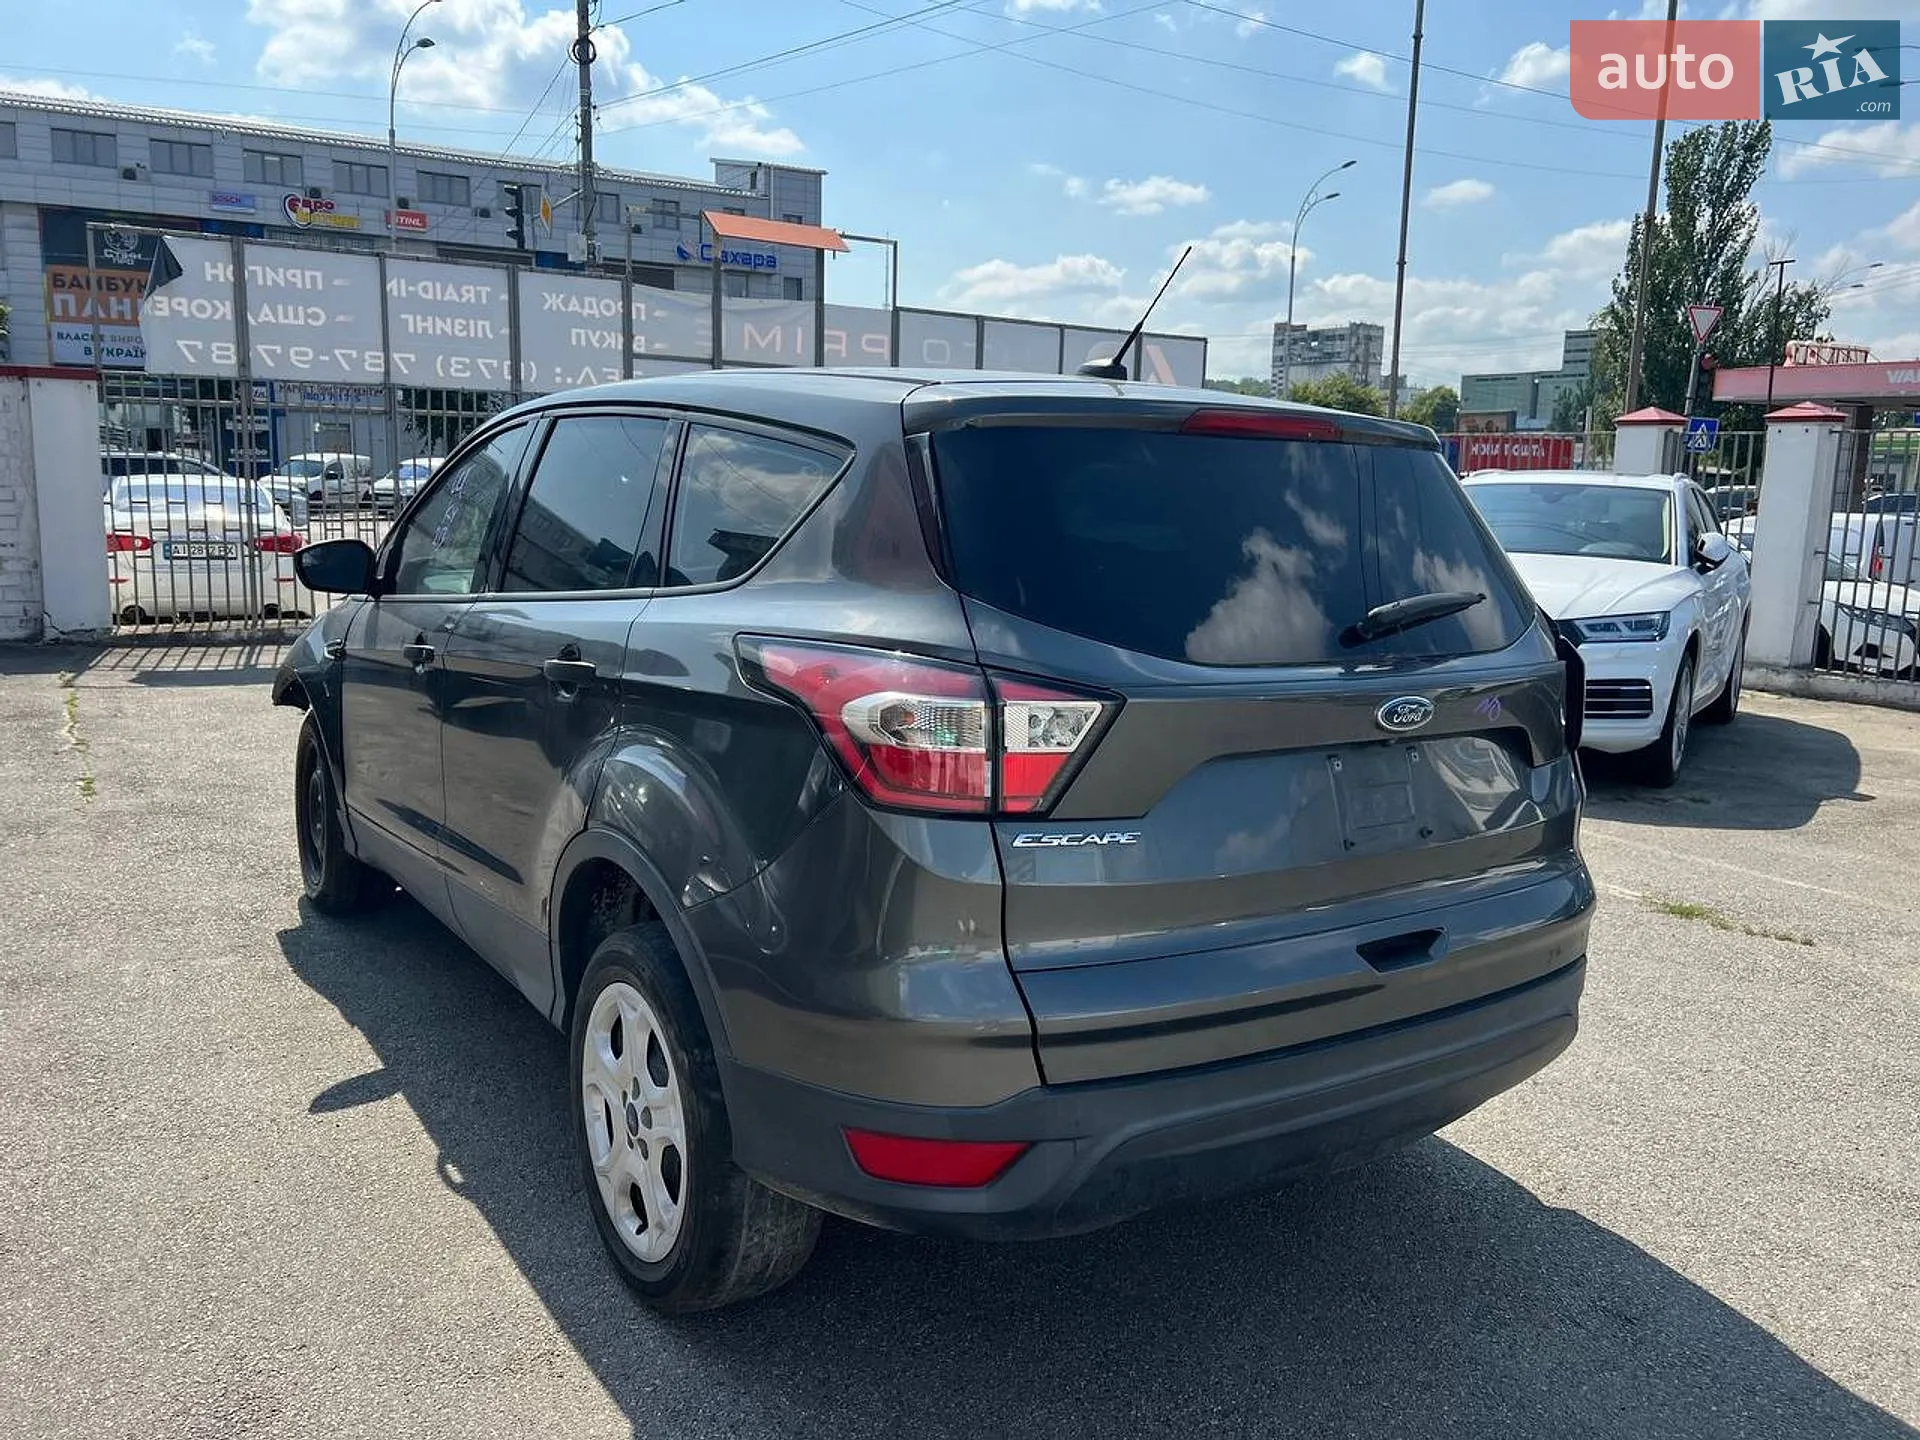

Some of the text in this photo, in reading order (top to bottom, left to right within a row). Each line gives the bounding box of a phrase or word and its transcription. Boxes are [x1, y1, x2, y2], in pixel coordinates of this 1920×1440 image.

[393, 215, 423, 227] TIHL
[53, 292, 144, 320] ПАН
[1393, 703, 1425, 724] Ford
[1013, 832, 1141, 847] ESCAPE
